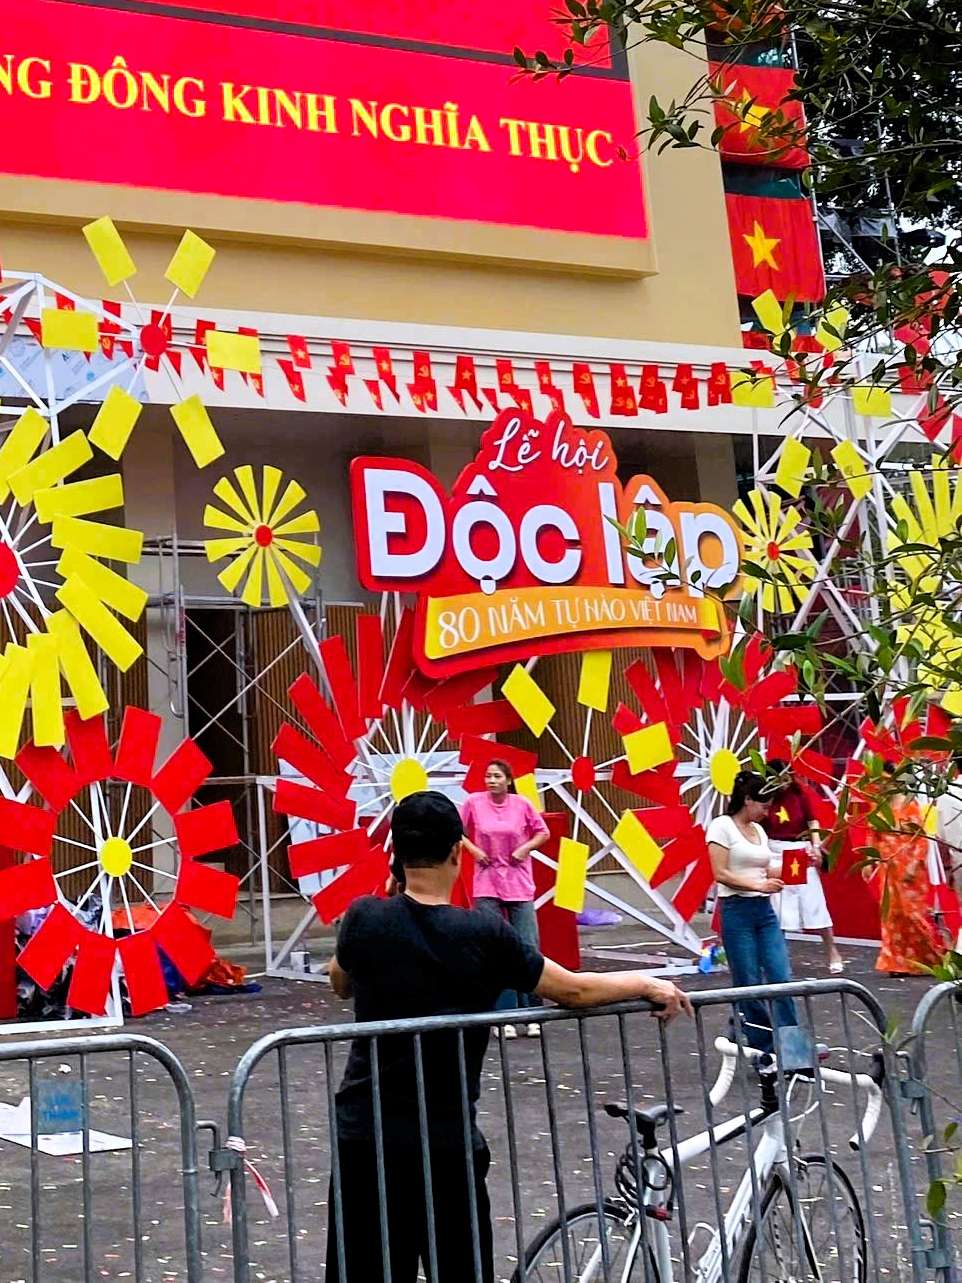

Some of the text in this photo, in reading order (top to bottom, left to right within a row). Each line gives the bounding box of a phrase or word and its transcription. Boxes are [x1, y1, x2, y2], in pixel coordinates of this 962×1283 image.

[67, 55, 207, 117] ĐÔNG
[220, 81, 339, 134] KINH
[349, 98, 494, 153] NGHĨA
[499, 116, 614, 174] THỤC
[488, 416, 611, 477] Lễ hội
[363, 467, 740, 600] Độc lập
[438, 593, 698, 649] 80 NĂM TỰ HÀO VIỆT NAM
